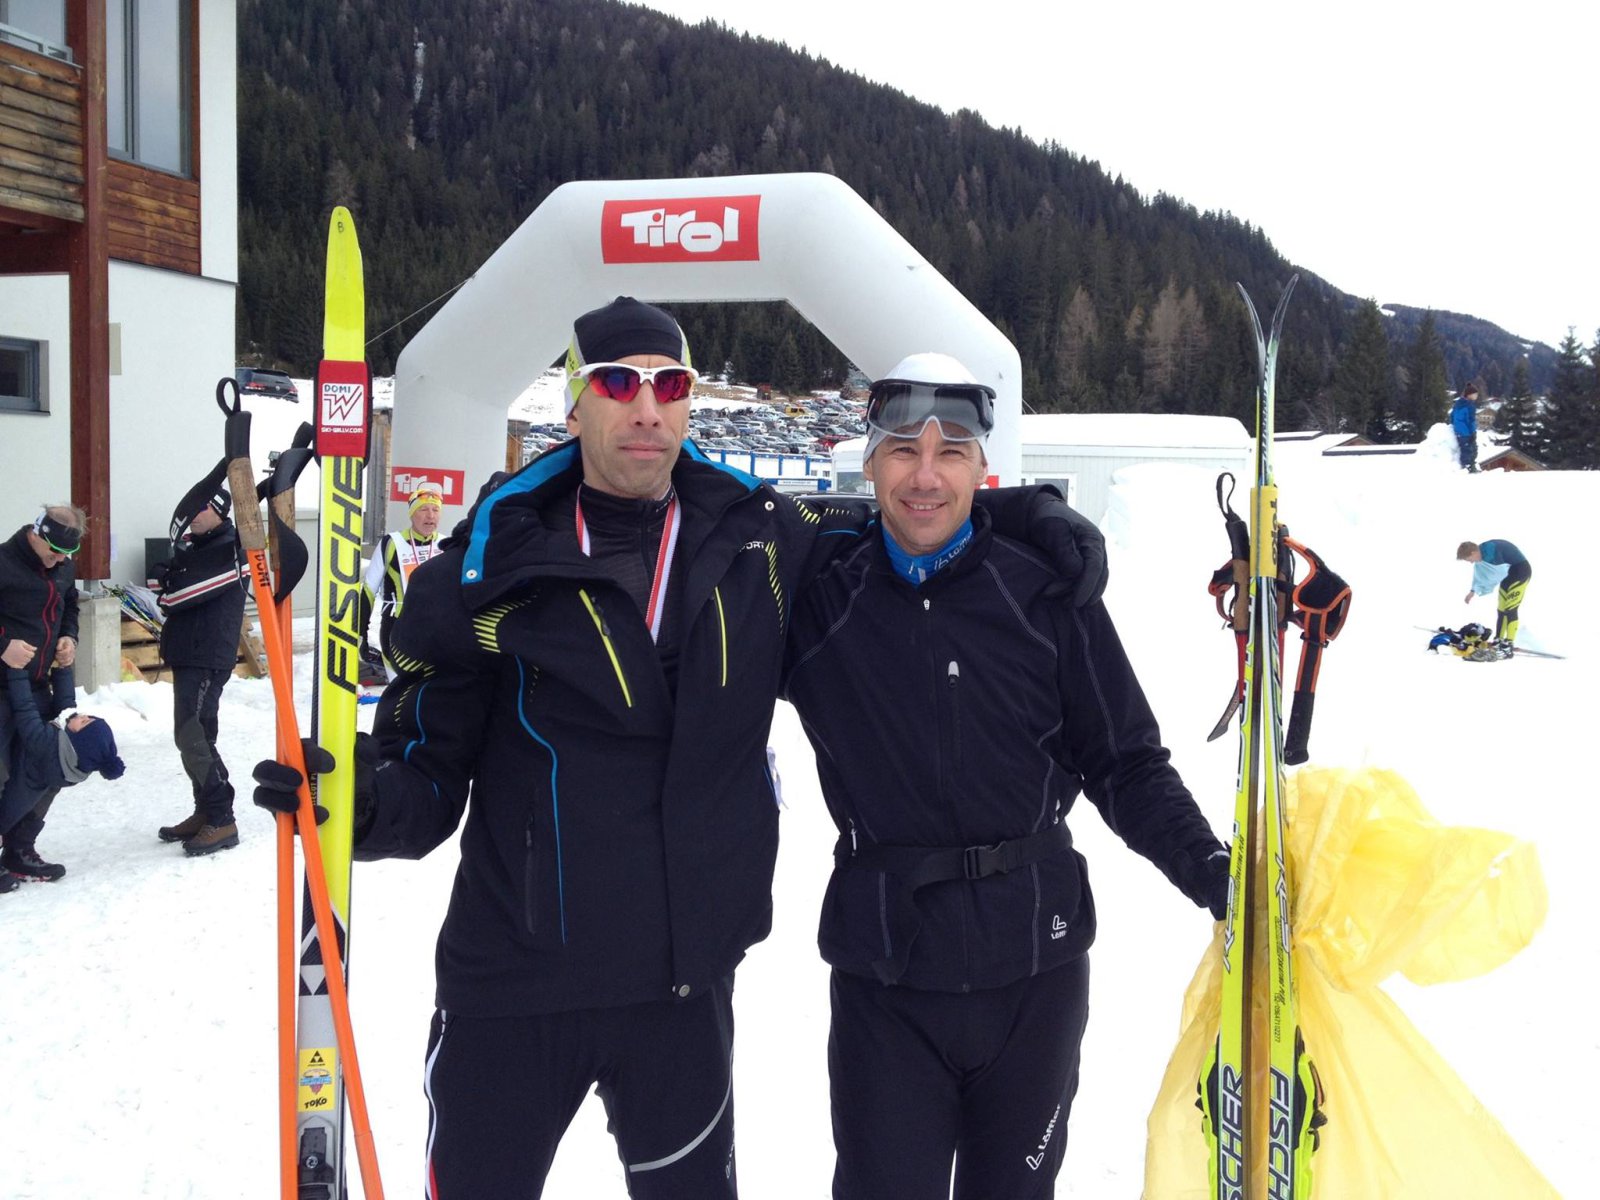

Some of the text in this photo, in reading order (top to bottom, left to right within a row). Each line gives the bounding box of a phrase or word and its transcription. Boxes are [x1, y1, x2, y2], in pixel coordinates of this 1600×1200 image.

[620, 205, 740, 253] Tirol
[323, 384, 352, 394] DOMI
[304, 1097, 328, 1109] TOKO
